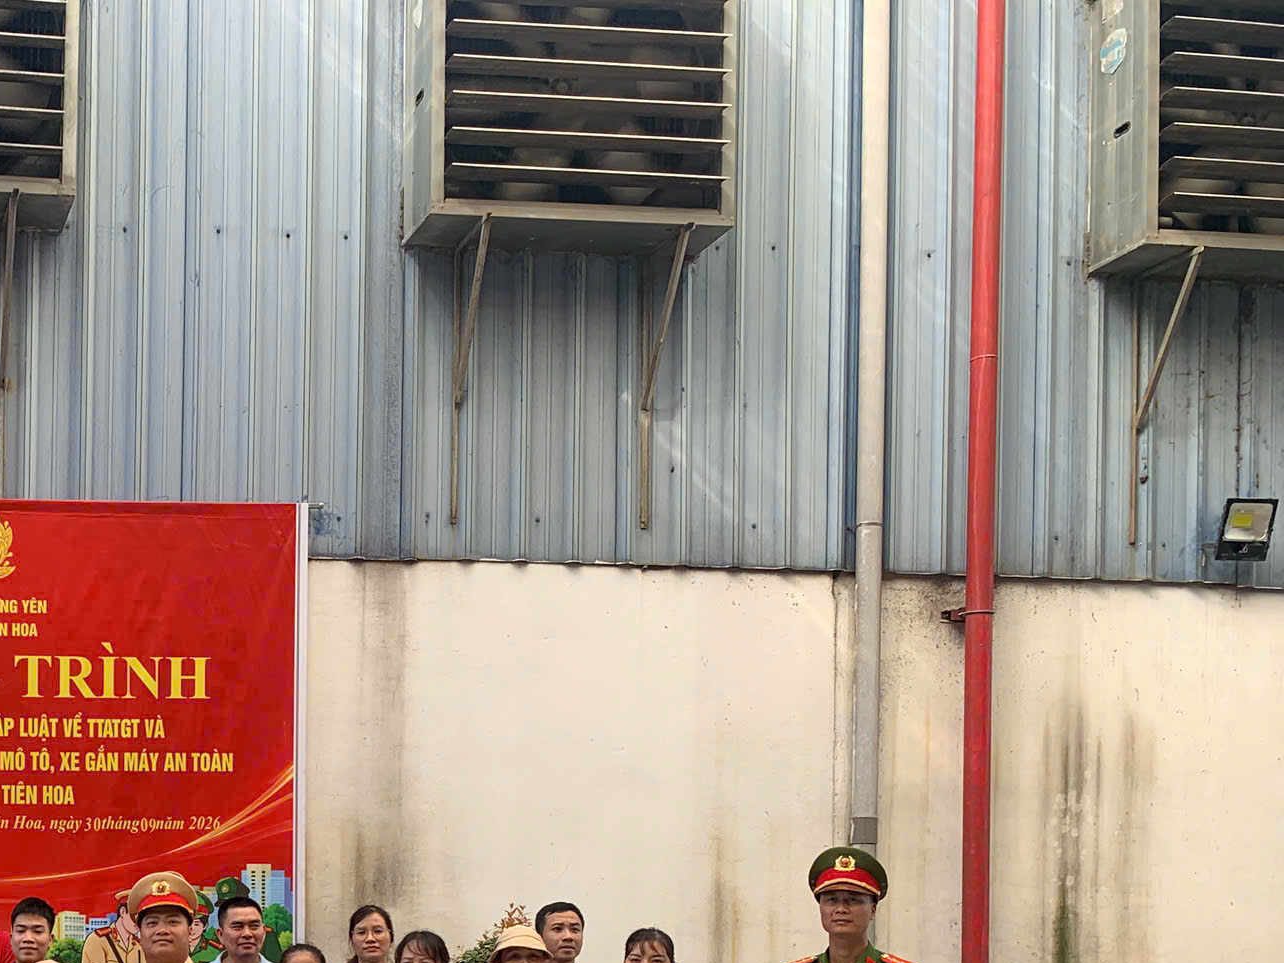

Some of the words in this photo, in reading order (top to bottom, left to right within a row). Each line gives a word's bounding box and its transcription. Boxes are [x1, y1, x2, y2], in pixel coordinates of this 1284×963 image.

[22, 597, 48, 614] YÊN
[11, 622, 38, 637] HOA
[14, 642, 211, 700] TRÌNH
[19, 713, 59, 742] LUẬT
[62, 712, 83, 738] VỀ
[86, 718, 141, 739] TTATGT
[144, 714, 165, 739] VÀ
[0, 747, 26, 771] MÔ
[30, 747, 55, 774] TÔ,
[59, 751, 80, 772] XE
[85, 745, 119, 772] GẮN
[123, 749, 159, 772] MÁY
[163, 752, 187, 772] AN
[191, 749, 234, 772] TOÀN
[1, 781, 38, 805] TIÊN
[42, 785, 75, 805] HOA
[13, 815, 45, 831] Hoa,
[49, 815, 83, 834] ngày
[188, 815, 221, 831] 2026
